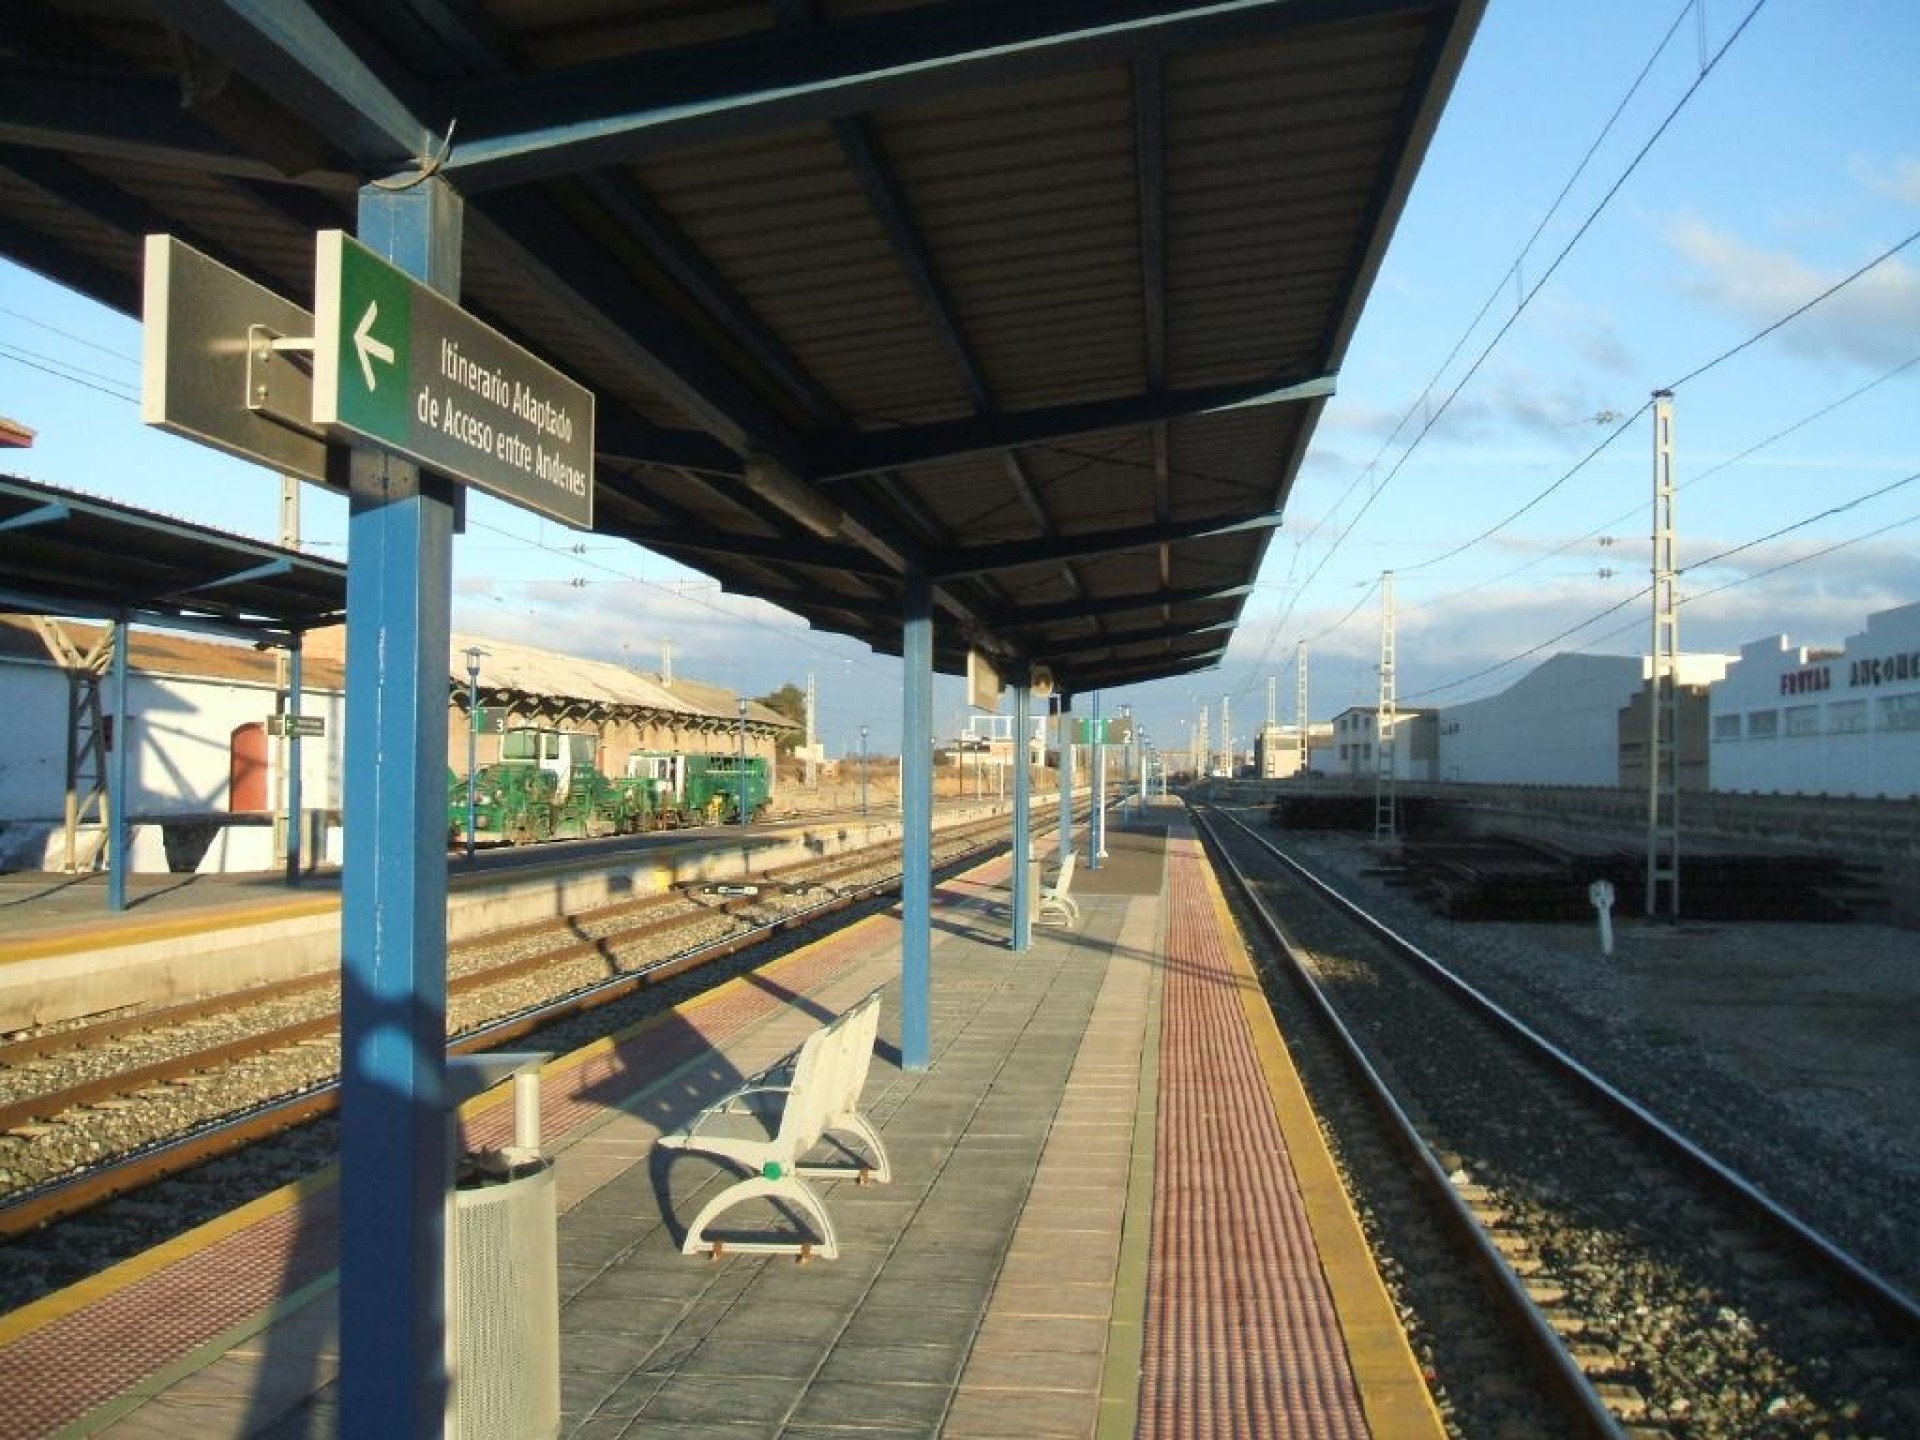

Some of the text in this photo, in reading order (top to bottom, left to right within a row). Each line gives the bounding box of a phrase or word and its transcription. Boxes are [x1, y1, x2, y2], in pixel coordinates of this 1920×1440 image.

[417, 385, 586, 496] de Acceso entre Andenes
[441, 337, 573, 443] Itinerario Adaptado
